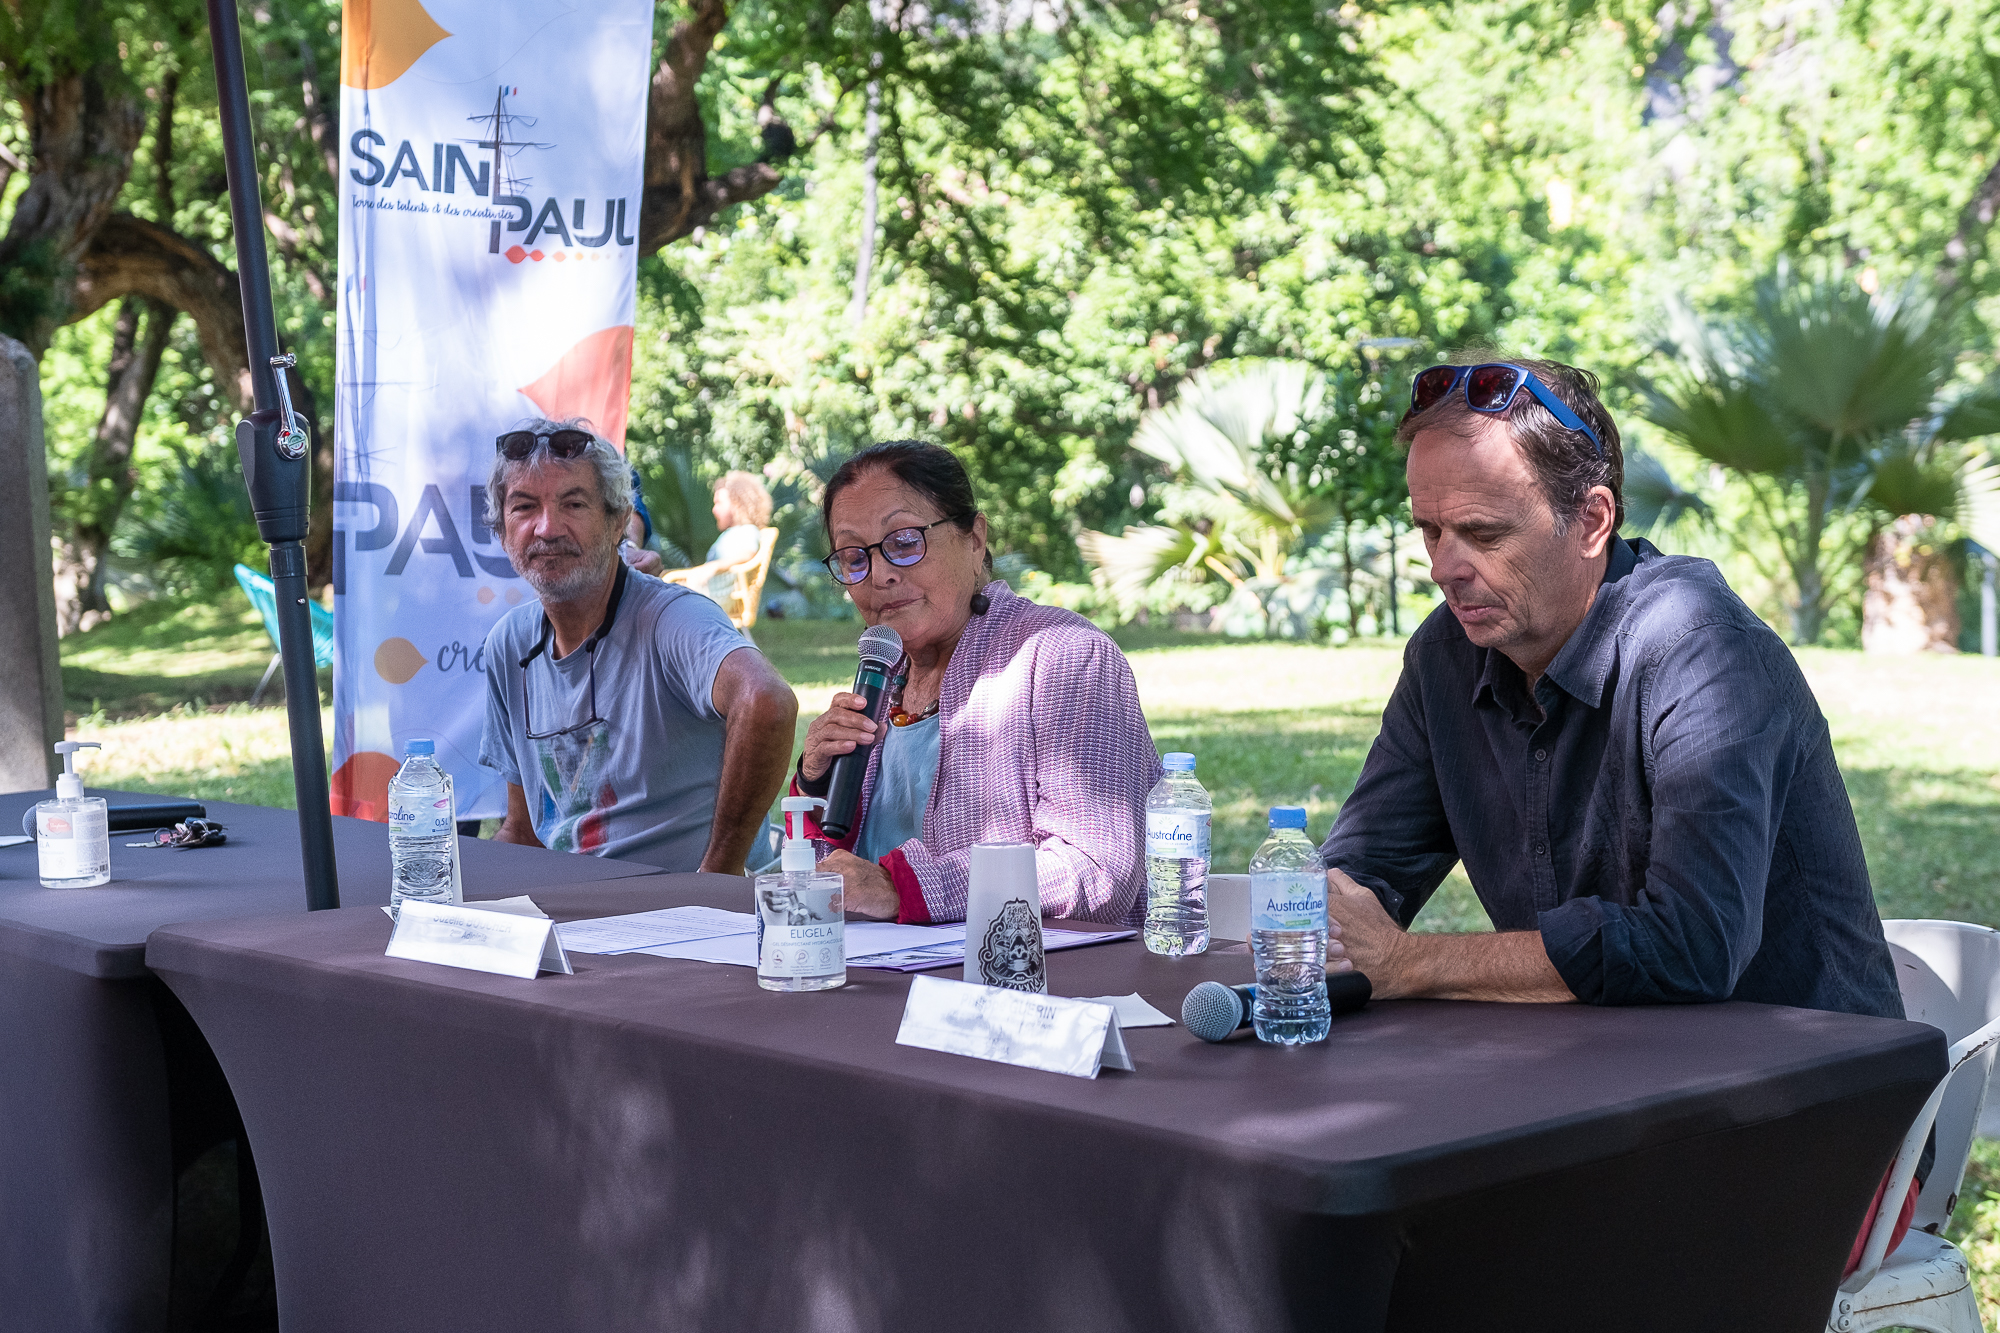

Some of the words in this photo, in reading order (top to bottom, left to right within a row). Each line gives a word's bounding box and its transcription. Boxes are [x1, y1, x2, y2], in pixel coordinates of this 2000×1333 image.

[351, 194, 375, 209] Terre
[376, 196, 394, 210] des
[397, 199, 429, 213] talents
[432, 201, 441, 214] et
[443, 203, 460, 216] des
[489, 195, 635, 253] PAUL
[1266, 891, 1323, 912] Australine
[790, 927, 825, 939] ELIGEL
[826, 927, 833, 936] A
